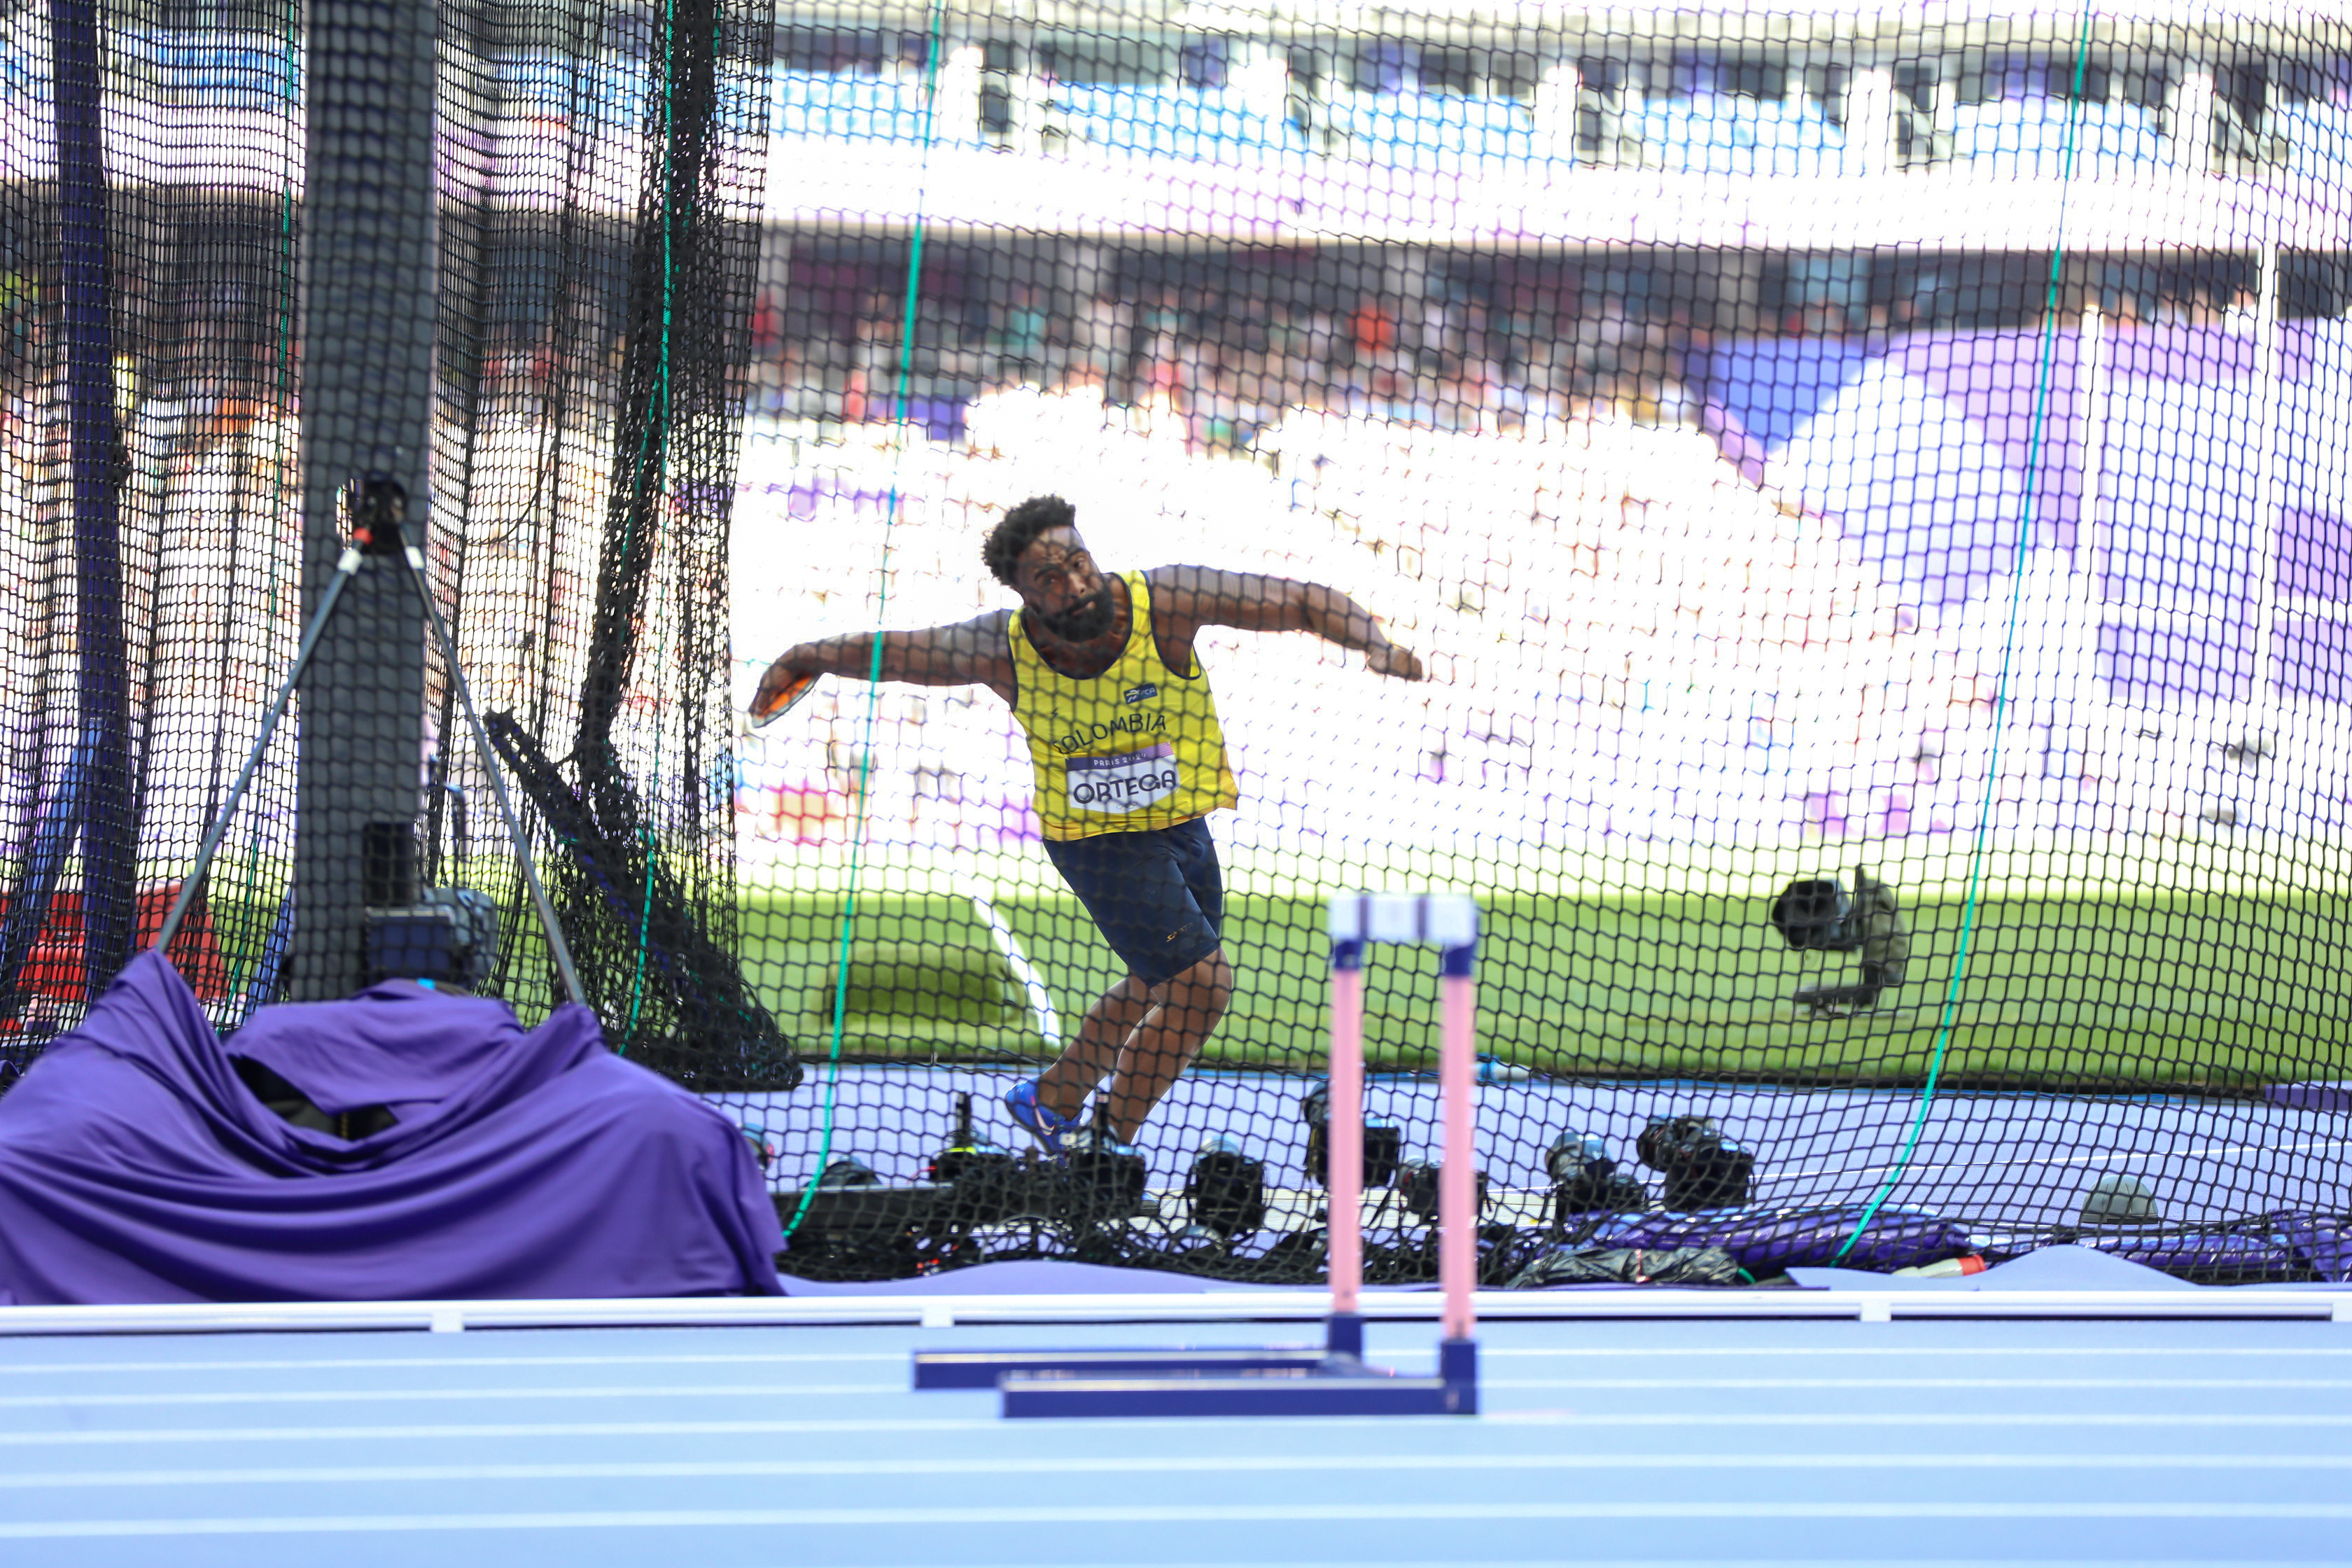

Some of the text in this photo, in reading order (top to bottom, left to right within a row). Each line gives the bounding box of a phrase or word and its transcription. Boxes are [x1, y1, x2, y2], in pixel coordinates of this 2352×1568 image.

[1052, 713, 1166, 754] COLOMBIA
[1093, 752, 1147, 766] PARIS 2024
[1073, 770, 1177, 804] ORTEGA
